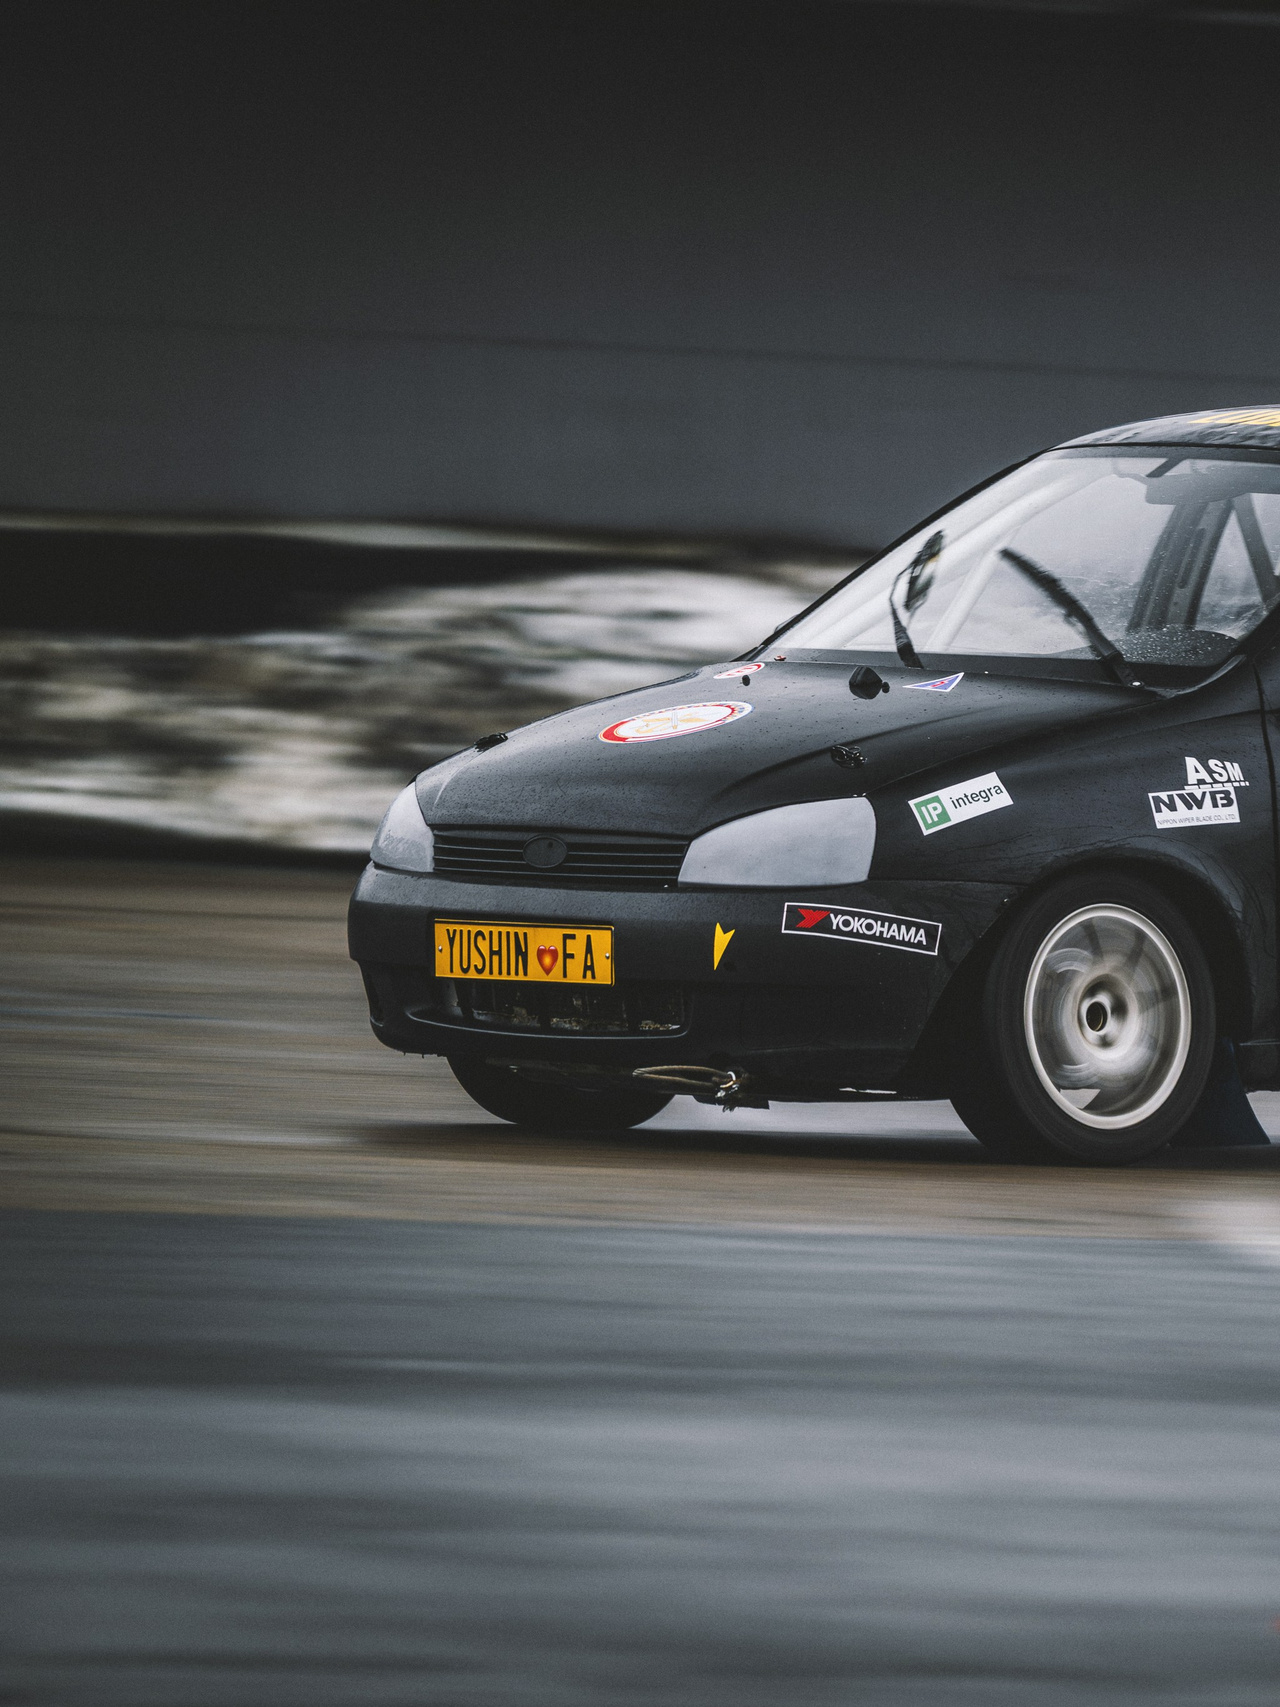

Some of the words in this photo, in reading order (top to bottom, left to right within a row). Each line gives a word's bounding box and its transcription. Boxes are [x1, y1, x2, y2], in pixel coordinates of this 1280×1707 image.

[1185, 756, 1245, 785] ASM
[920, 801, 943, 825] IP
[950, 784, 1004, 810] integra
[1151, 789, 1235, 814] NWB
[1178, 816, 1195, 824] WIPER
[1195, 815, 1213, 823] BLADE
[829, 913, 927, 946] YOKOHAMA
[446, 928, 529, 977] YUSHIN
